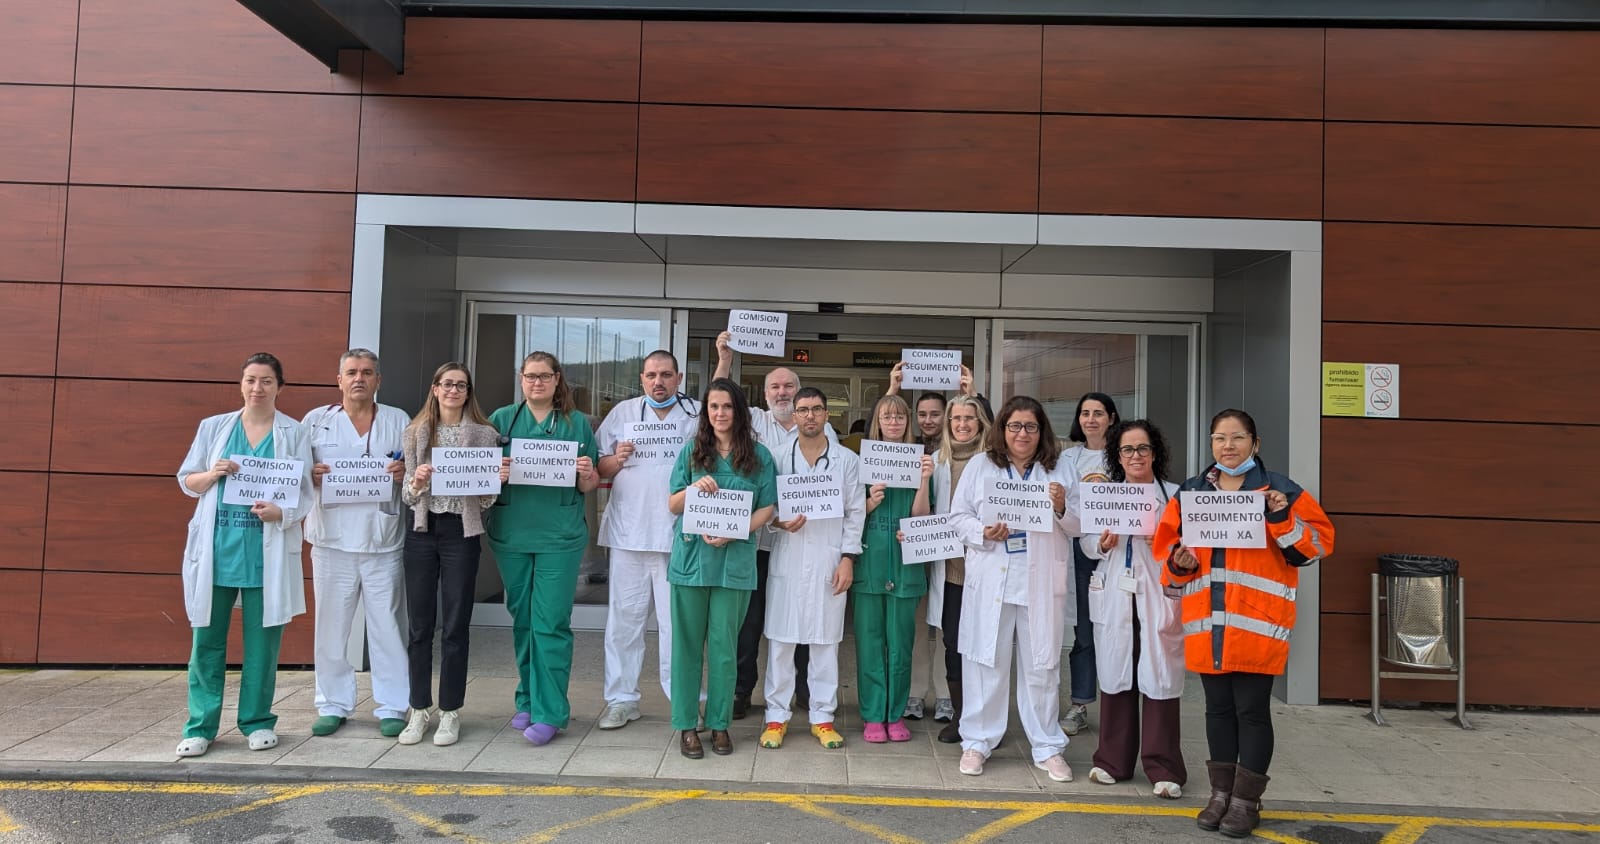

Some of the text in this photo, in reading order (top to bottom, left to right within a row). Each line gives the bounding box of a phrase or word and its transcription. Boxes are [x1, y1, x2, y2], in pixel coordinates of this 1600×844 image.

[739, 312, 780, 323] COMISION
[731, 325, 784, 337] SEGUIMENTO
[738, 338, 758, 348] MUH
[911, 350, 954, 359] COMISION
[905, 363, 959, 372] SEGUIMENTO
[633, 423, 677, 432] COMISION
[522, 442, 570, 452] COMISION
[871, 443, 916, 454] COMISION
[444, 450, 493, 459] COMISION
[635, 451, 657, 459] MUH
[242, 458, 294, 471] COMISION
[335, 460, 385, 469] COMISION
[514, 456, 575, 467] SEGUIMENTO
[864, 457, 921, 469] SEGUIMENTO
[436, 465, 500, 474] SEGUIMENTO
[231, 473, 299, 487] SEGUIMENTO
[327, 475, 391, 484] SEGUIMENTO
[523, 471, 566, 481] MUH XA
[787, 475, 833, 485] COMISION
[871, 473, 912, 482] MUH XA
[446, 480, 490, 489] MUH XA
[995, 481, 1045, 493] COMISION
[239, 488, 287, 501] MUH XA
[336, 489, 381, 497] MUH XA
[782, 488, 840, 500] SEGUIMENTO
[1091, 485, 1145, 495] COMISION
[697, 490, 744, 502] COMISION
[1195, 495, 1254, 505] COMISION
[988, 495, 1051, 509] SEGUIMENTO
[1084, 500, 1152, 512] SEGUIMENTO
[688, 504, 749, 517] SEGUIMENTO
[791, 503, 832, 514] MUH XA
[232, 511, 258, 520] EXCLUS
[997, 512, 1042, 524] MUH XA
[1187, 512, 1263, 522] SEGUIMENTO
[696, 520, 739, 531] MUH XA
[910, 516, 948, 528] COMISIO
[1094, 517, 1142, 528] MUH XA
[1200, 530, 1253, 540] MUH XA
[915, 545, 954, 557] MUH XA
